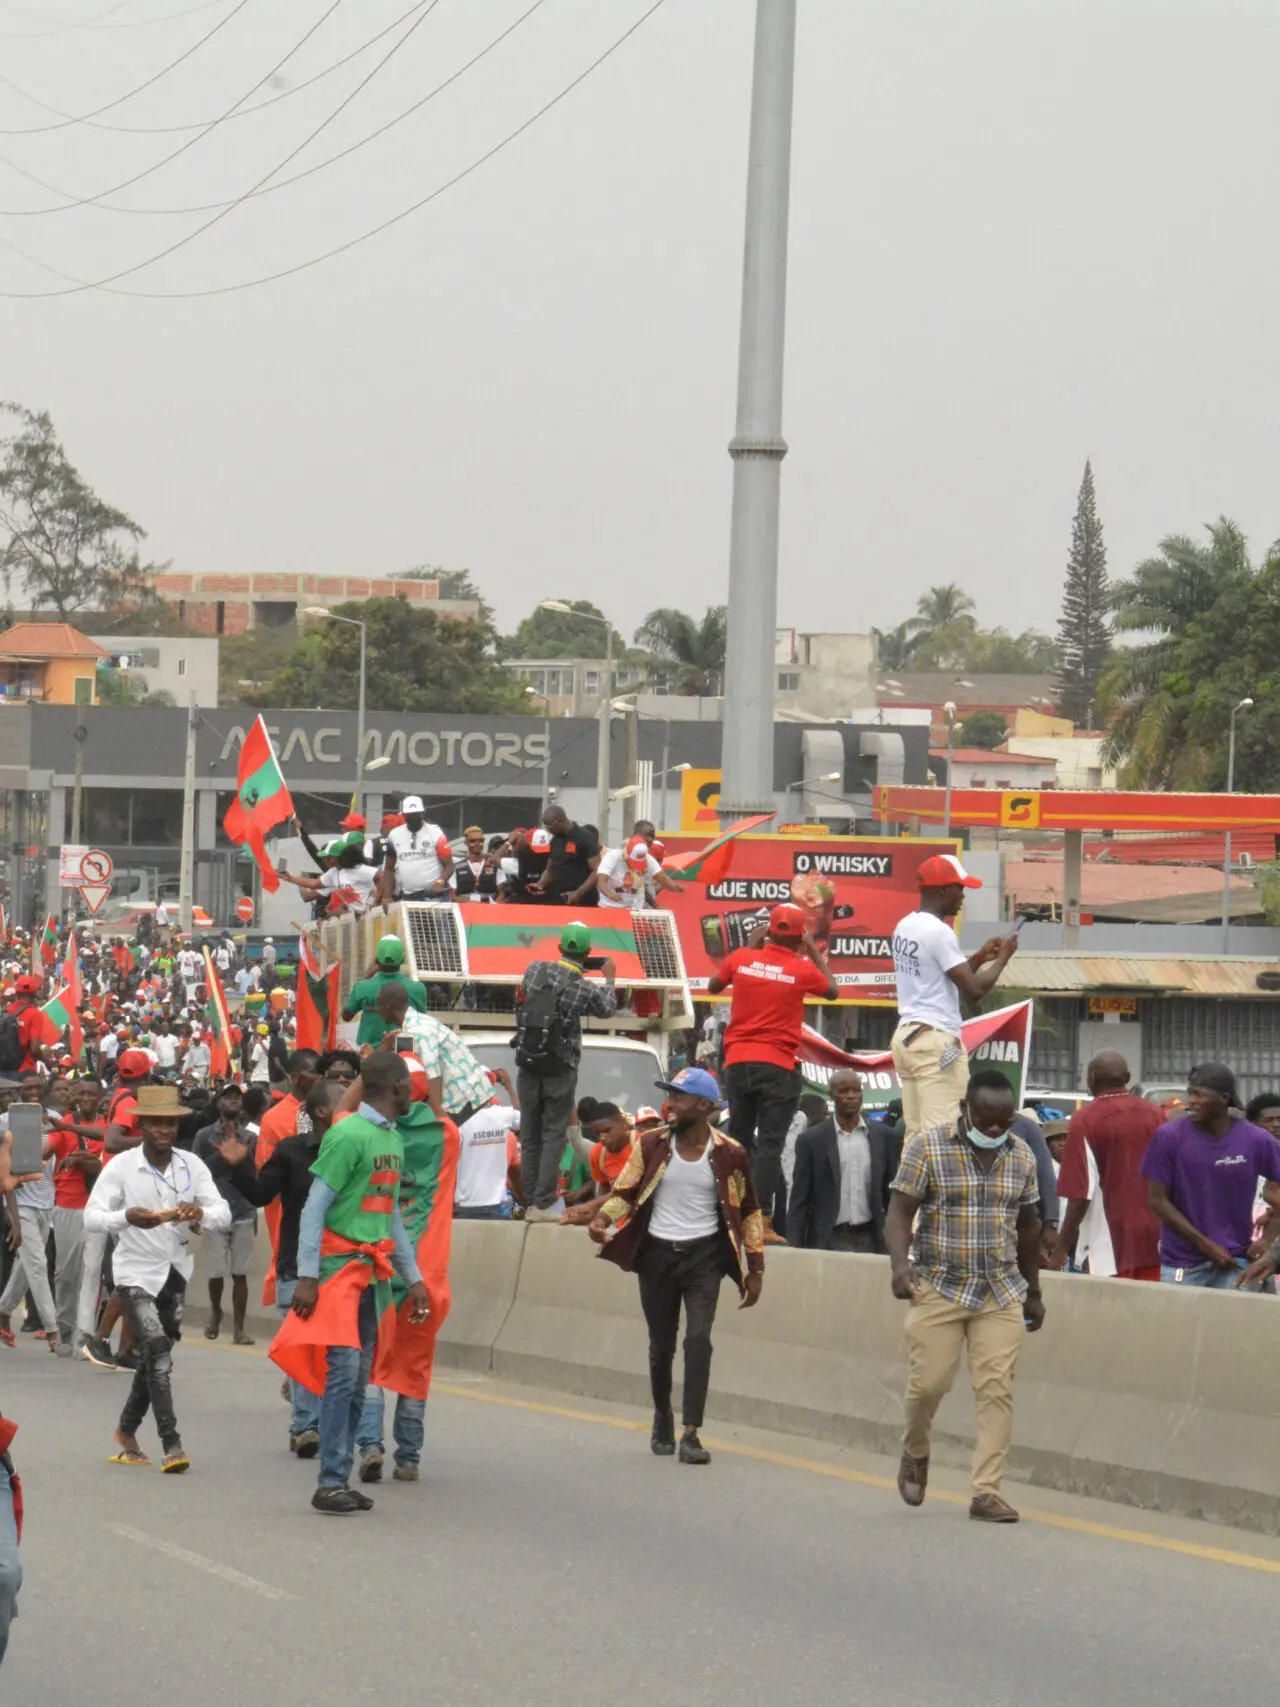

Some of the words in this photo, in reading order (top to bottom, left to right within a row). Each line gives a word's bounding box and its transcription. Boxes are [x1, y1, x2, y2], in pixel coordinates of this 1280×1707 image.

[356, 729, 551, 769] MOTORS
[797, 855, 810, 871] O
[814, 855, 888, 873] WHISKY
[710, 881, 748, 898] QUE
[751, 882, 791, 898] NOS
[831, 938, 891, 956] JUNTA
